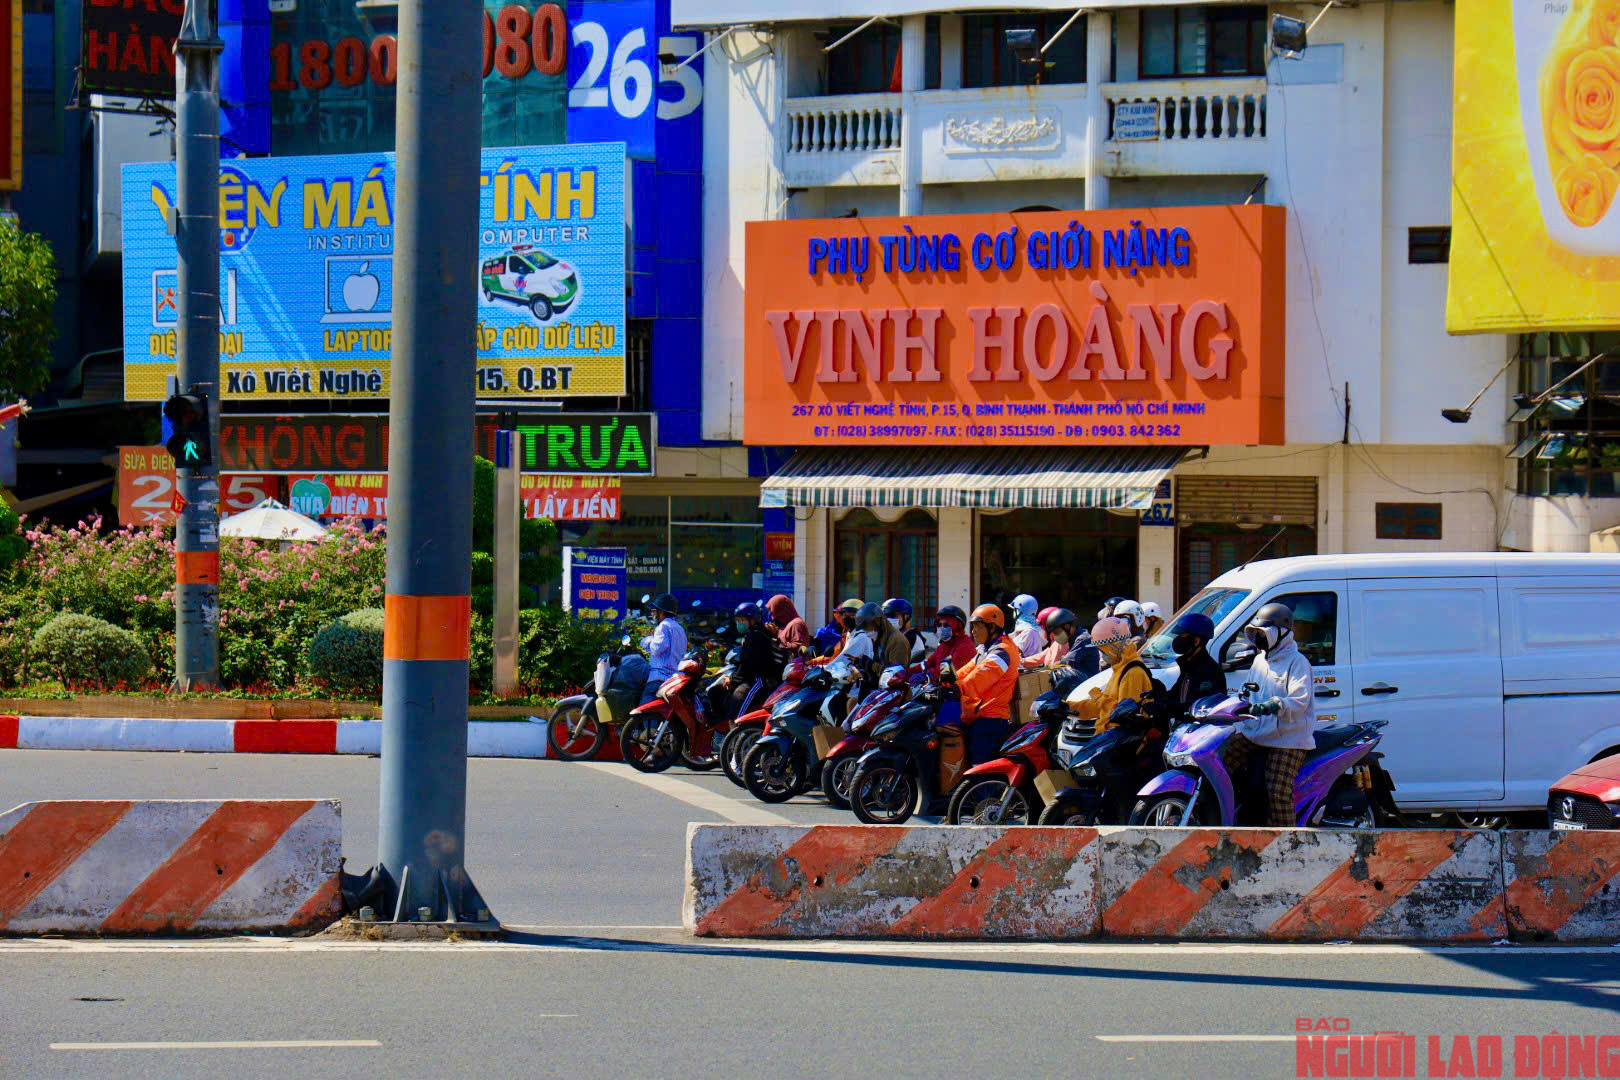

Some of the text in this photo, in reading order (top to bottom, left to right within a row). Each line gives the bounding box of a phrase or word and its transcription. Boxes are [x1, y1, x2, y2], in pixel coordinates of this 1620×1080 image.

[568, 21, 703, 120] 265
[303, 161, 392, 229] MÁ
[482, 226, 591, 245] OMPUTER
[809, 219, 1190, 283] PHỤ TÙNG CƠ GIỚI NẶNG
[574, 319, 616, 353] LIỆU
[765, 280, 1234, 383] VINH HOÀNG
[227, 370, 256, 393] Xô
[264, 367, 304, 393] Viết
[319, 369, 382, 396] Nghệ
[517, 367, 573, 392] Q.BT
[792, 404, 814, 417] 267
[1173, 402, 1206, 415] MINH
[516, 416, 649, 469] TRƯA
[965, 424, 997, 438] (028)
[1130, 424, 1154, 437] 842
[1158, 424, 1181, 437] 362
[131, 475, 266, 508] 25
